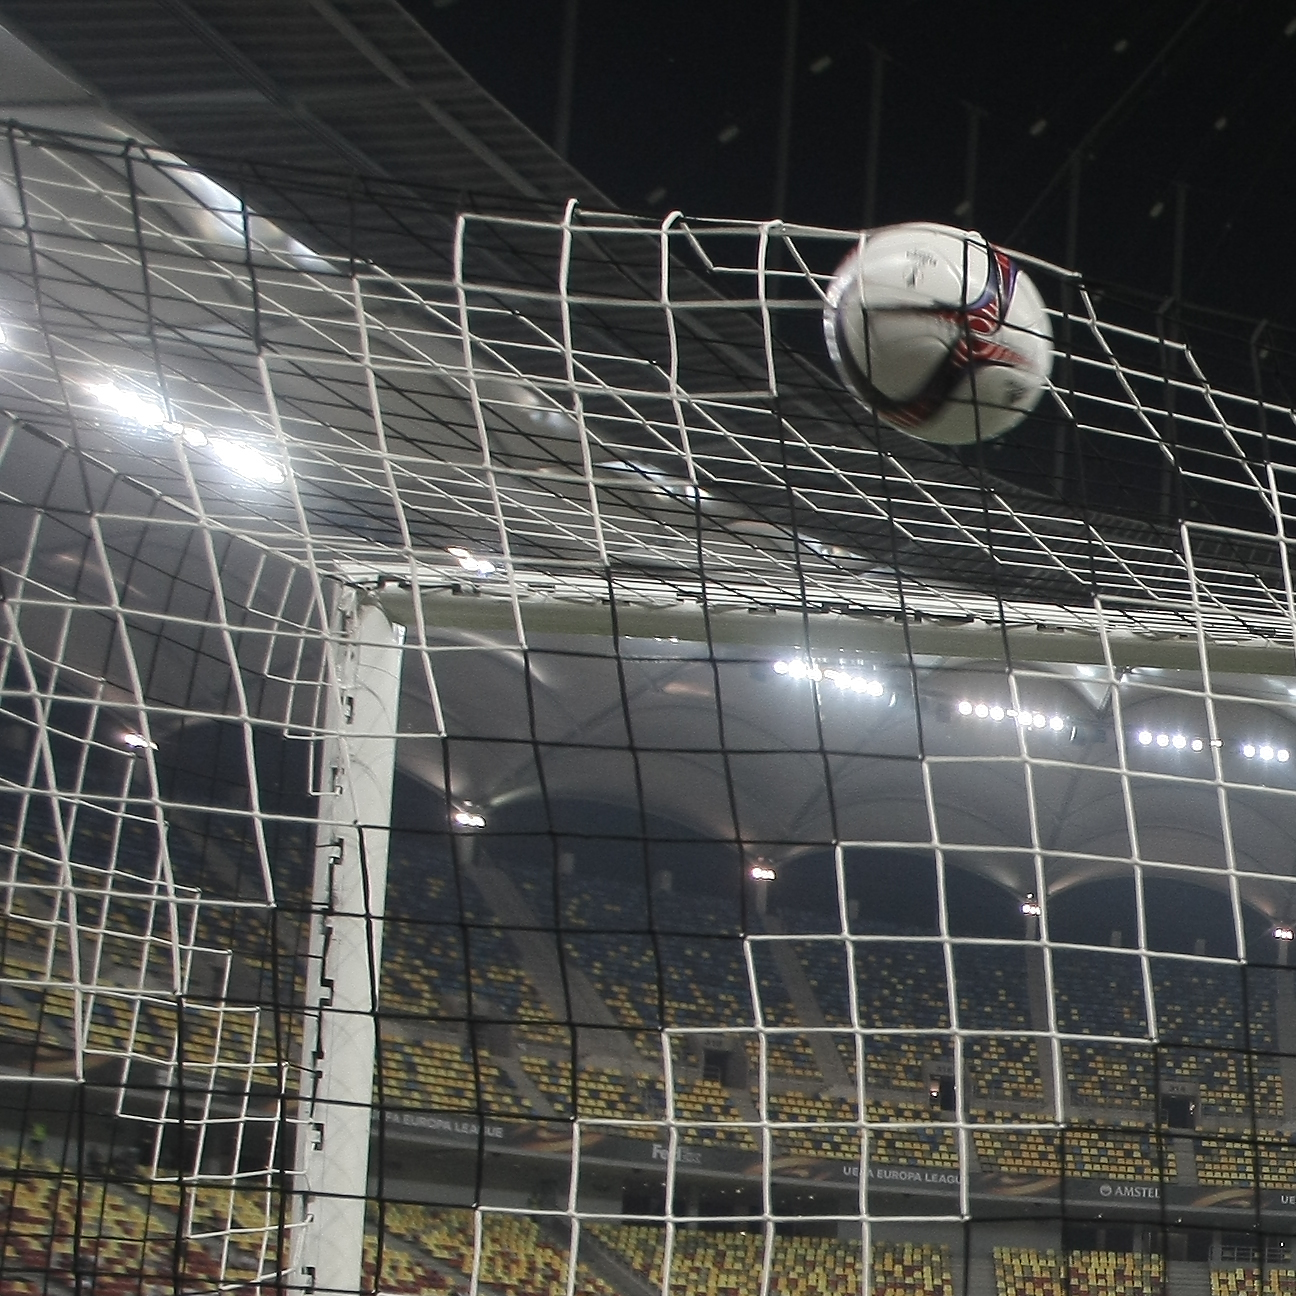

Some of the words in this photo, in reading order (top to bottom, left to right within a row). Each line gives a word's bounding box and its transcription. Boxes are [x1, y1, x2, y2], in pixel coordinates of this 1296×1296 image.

[454, 1122, 503, 1138] LEAUE
[843, 1165, 873, 1178] UEA
[876, 1169, 922, 1182] EUROPA
[924, 1173, 961, 1184] LEAGU
[1115, 1186, 1161, 1198] AMSTEL
